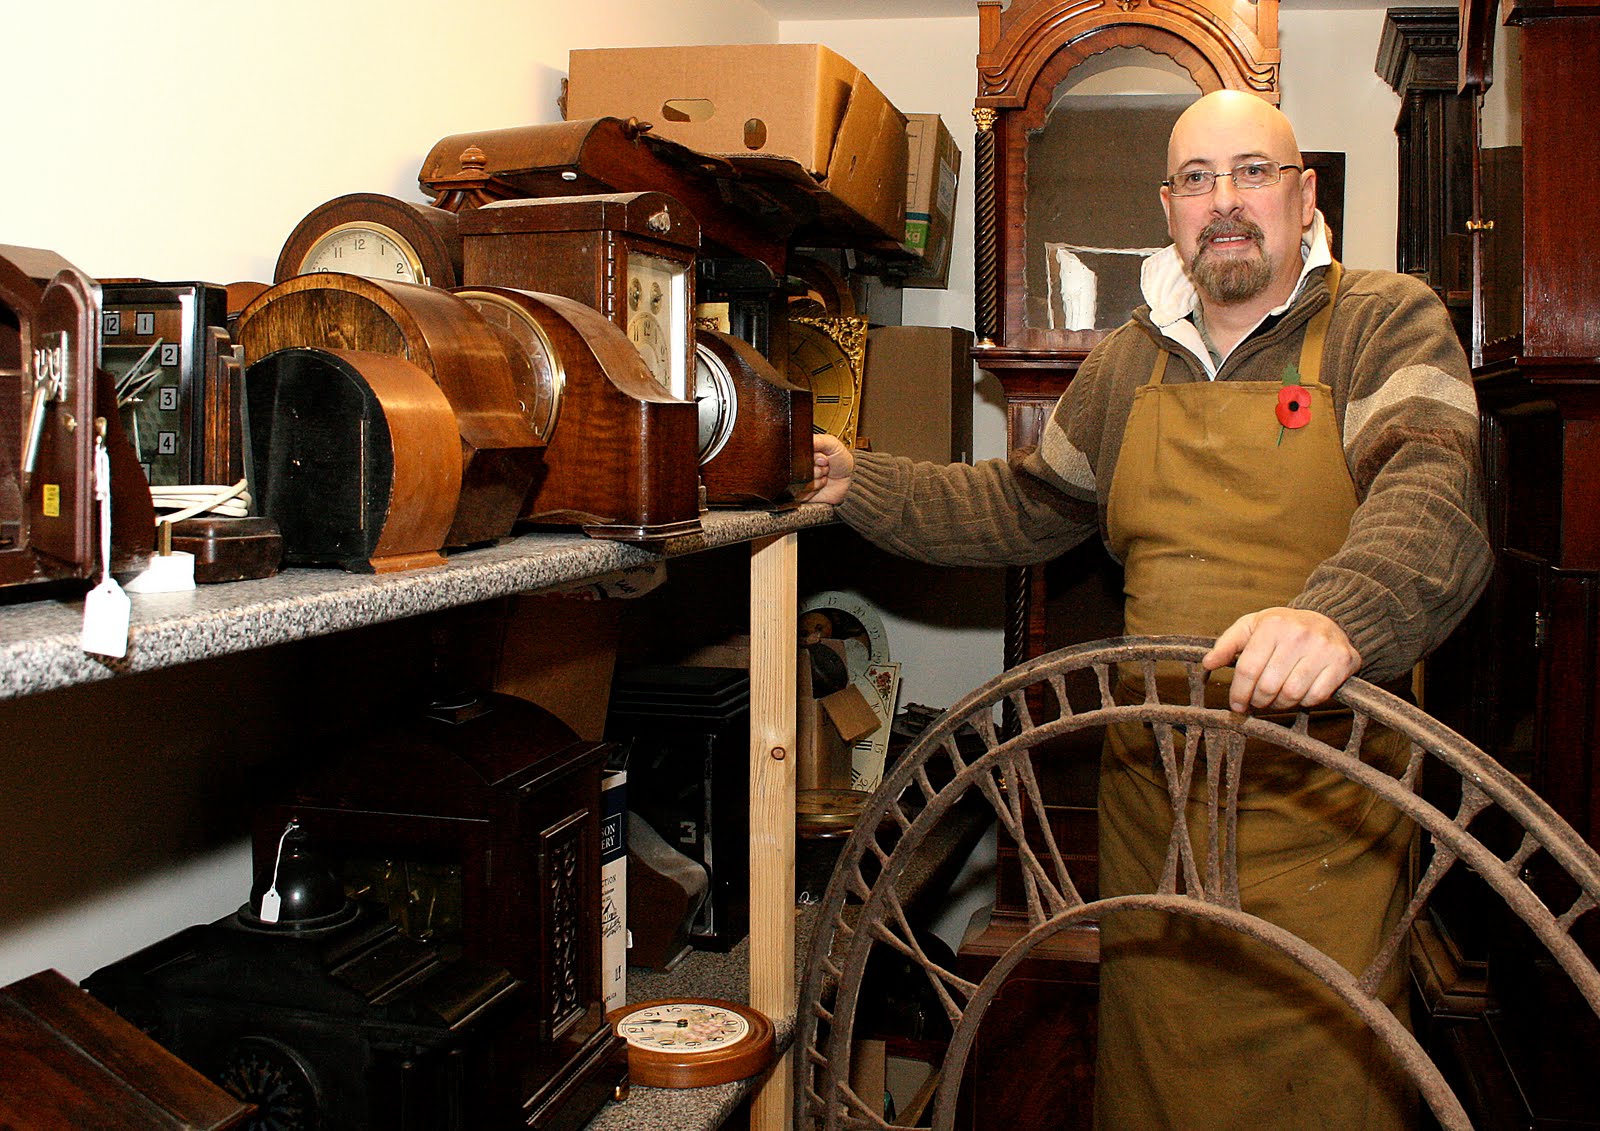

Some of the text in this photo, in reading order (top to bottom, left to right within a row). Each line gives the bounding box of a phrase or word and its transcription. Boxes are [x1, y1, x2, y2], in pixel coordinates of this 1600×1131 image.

[354, 238, 365, 250] 12
[334, 247, 343, 259] 11
[396, 262, 404, 274] 2
[105, 317, 117, 331] 12
[164, 348, 174, 362] 2
[163, 392, 173, 406] 3
[162, 436, 173, 450] 4
[679, 821, 697, 844] 3
